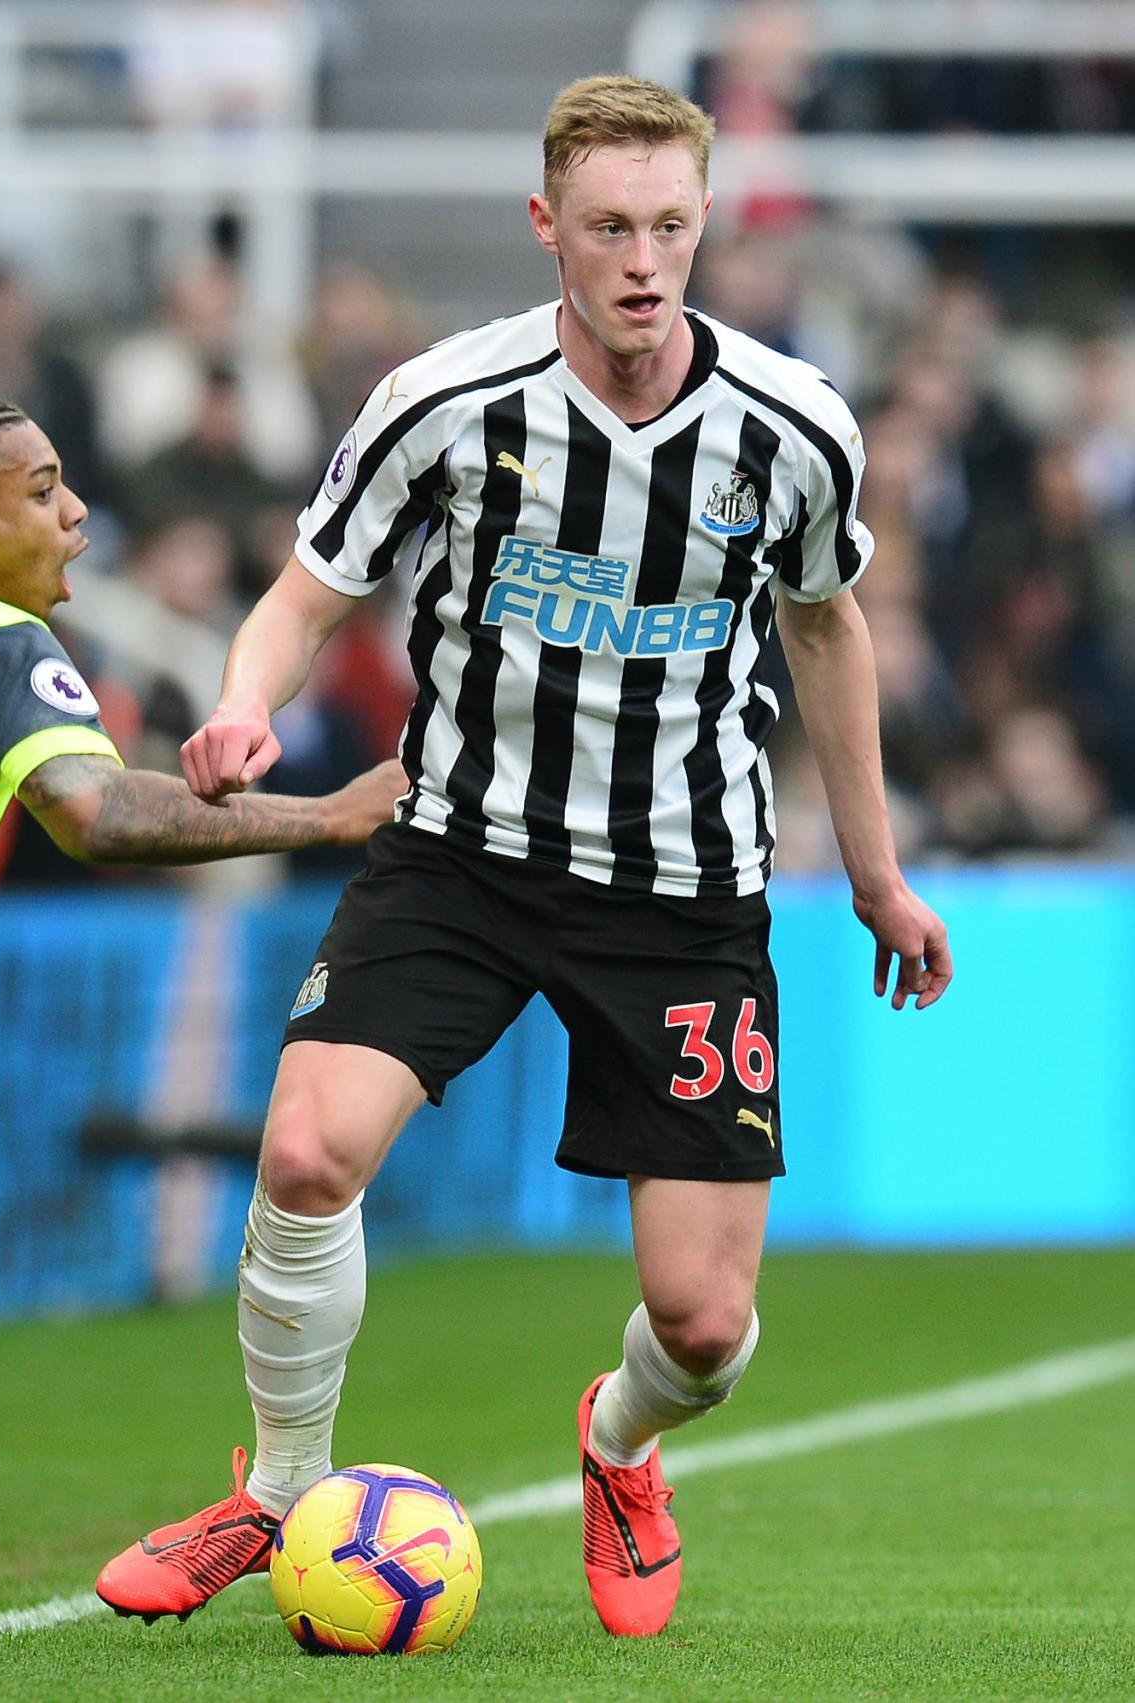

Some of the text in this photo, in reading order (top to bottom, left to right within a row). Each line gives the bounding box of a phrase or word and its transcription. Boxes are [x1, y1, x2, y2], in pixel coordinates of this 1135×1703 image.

[493, 538, 629, 599] 乐天堂
[484, 582, 734, 655] FUN88
[665, 997, 775, 1100] 36
